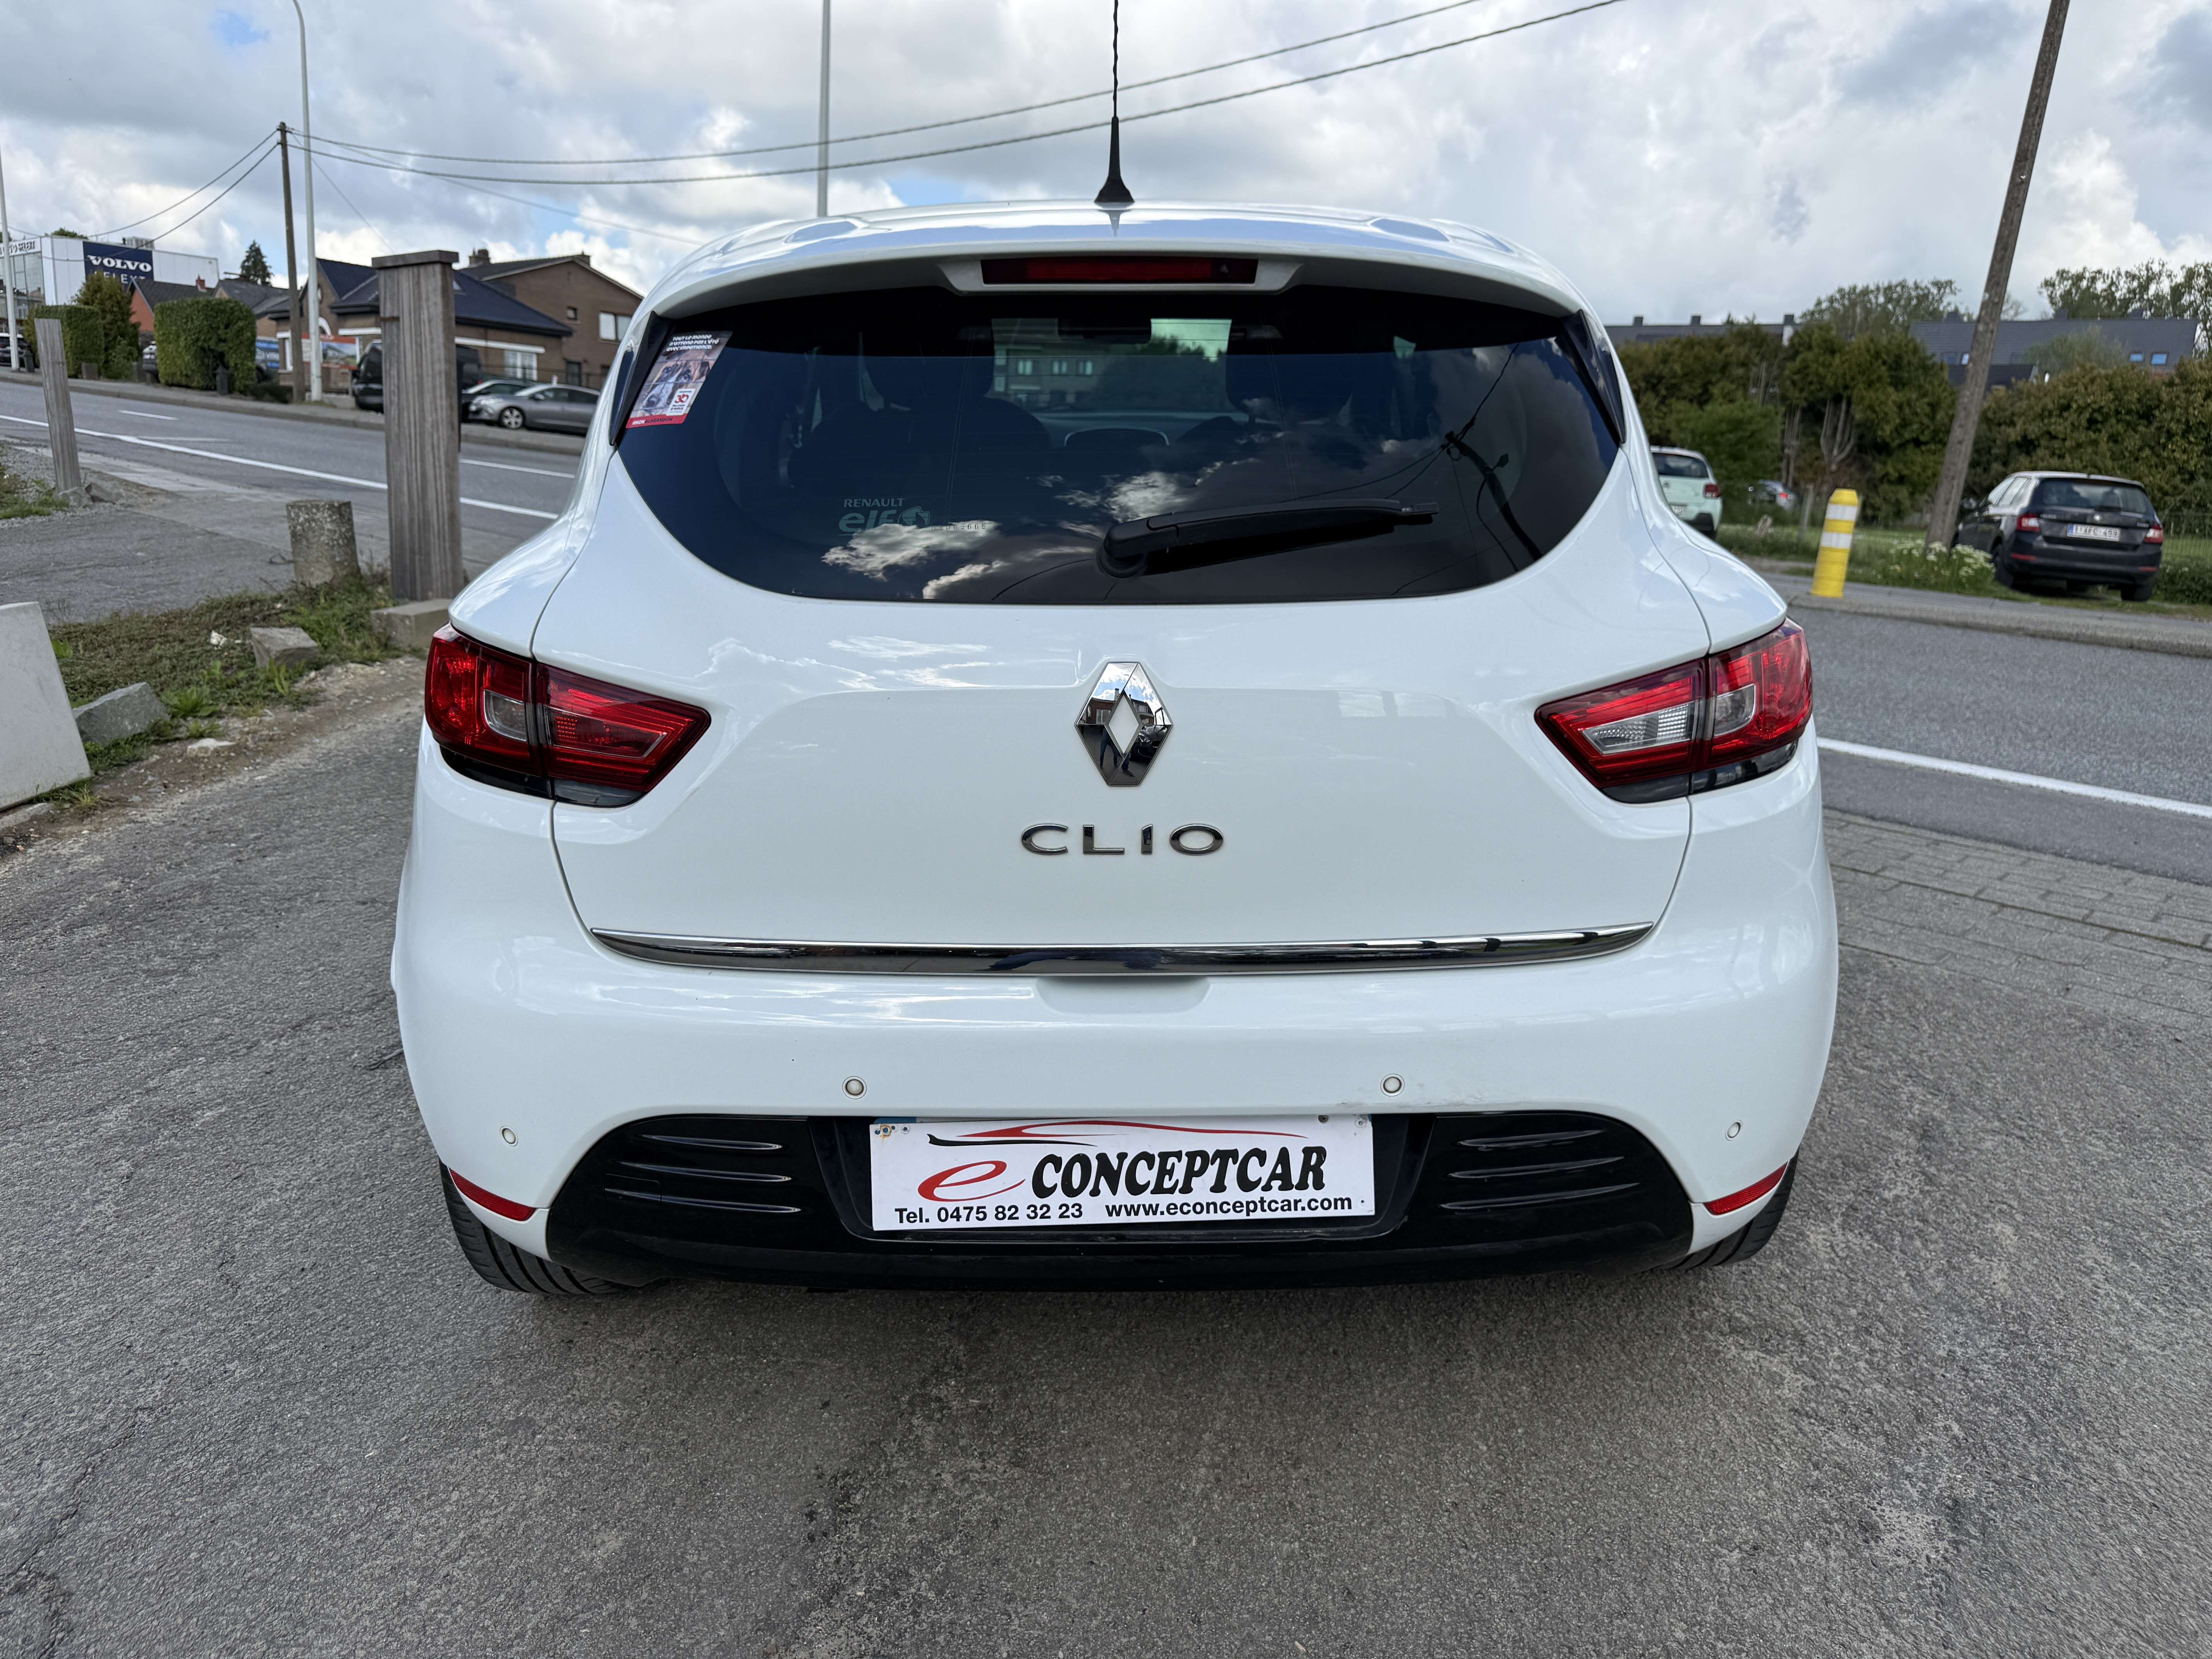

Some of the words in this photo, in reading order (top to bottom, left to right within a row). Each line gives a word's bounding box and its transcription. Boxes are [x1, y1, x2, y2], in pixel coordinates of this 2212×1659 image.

[87, 255, 152, 272] VOLVO
[843, 498, 905, 508] RENAULT
[839, 510, 897, 533] elf
[1022, 823, 1223, 855] CLIO
[917, 1160, 1026, 1202] e
[1032, 1146, 1327, 1199] CONCEPTCAR
[895, 1207, 929, 1223] Tel.
[937, 1206, 987, 1222] 0475
[994, 1205, 1019, 1220] 82
[1026, 1204, 1051, 1219] 32
[1058, 1203, 1083, 1219] 23
[1105, 1196, 1352, 1217] www.econceptcar.com
